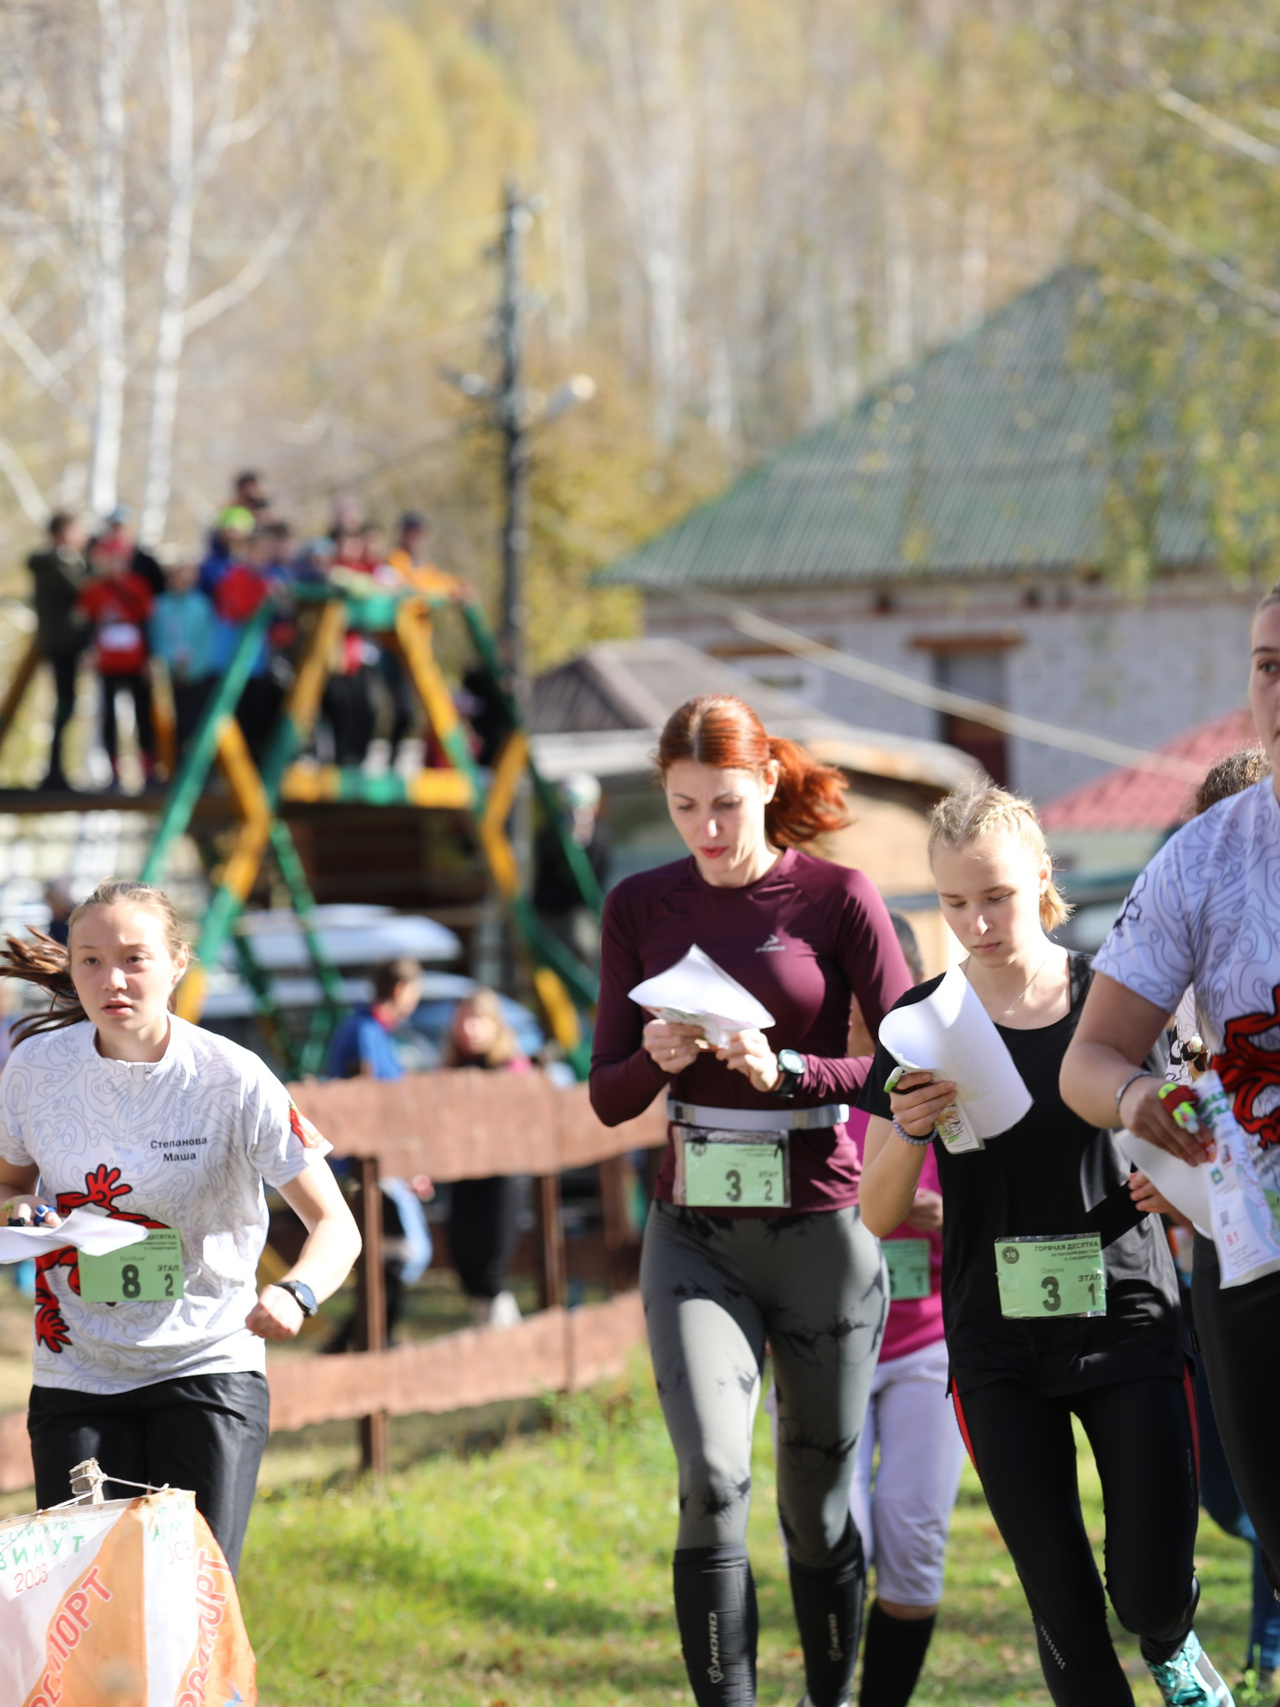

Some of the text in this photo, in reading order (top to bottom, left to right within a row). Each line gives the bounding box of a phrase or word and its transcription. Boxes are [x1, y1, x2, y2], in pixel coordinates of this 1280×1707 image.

[150, 1137, 207, 1149] Степанова
[163, 1153, 197, 1161] Маша
[725, 1169, 774, 1203] 3 2
[1034, 1241, 1100, 1252] ГОРЯЧАЯ ДЕСЯТКА
[121, 1264, 174, 1299] 8 2
[1078, 1273, 1102, 1282] ЭТАП
[1041, 1276, 1096, 1312] 3 1
[709, 1612, 719, 1665] NORD
